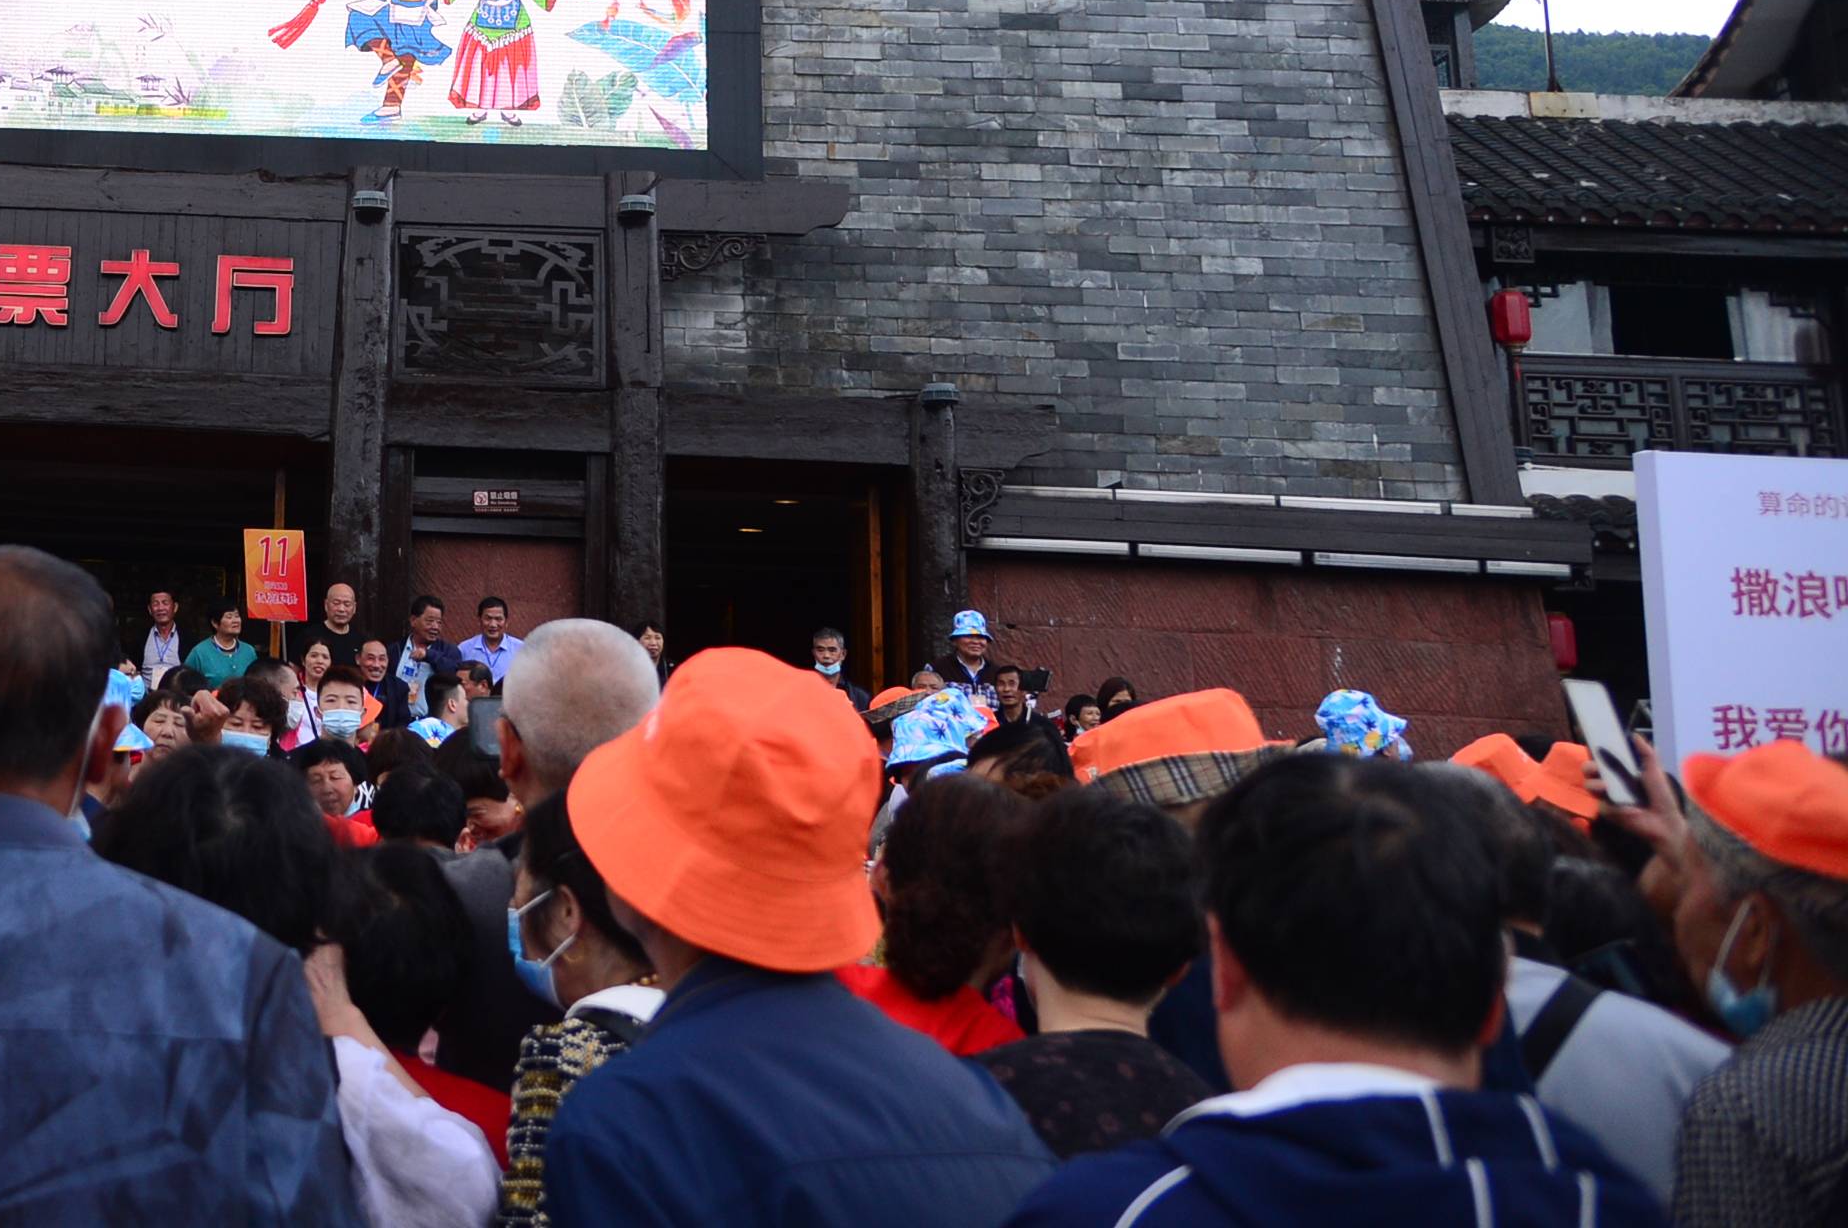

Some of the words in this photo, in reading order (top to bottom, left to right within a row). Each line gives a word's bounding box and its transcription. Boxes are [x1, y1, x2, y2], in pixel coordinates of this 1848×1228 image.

[1757, 491, 1848, 519] 算命的
[259, 535, 289, 577] 11
